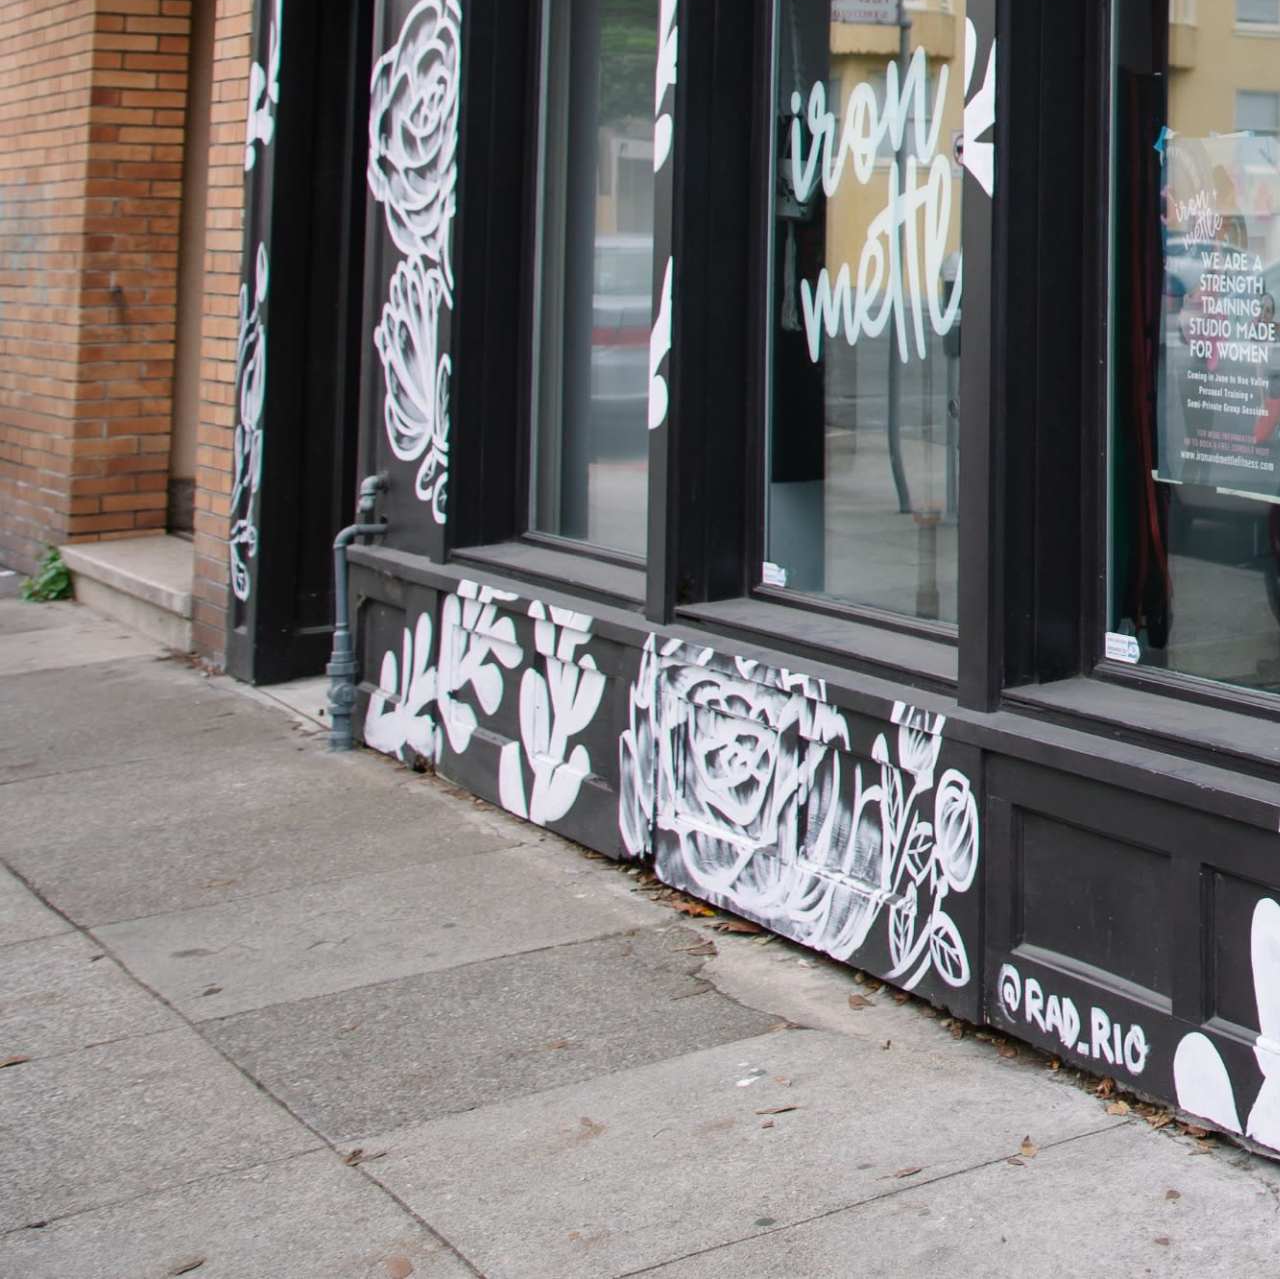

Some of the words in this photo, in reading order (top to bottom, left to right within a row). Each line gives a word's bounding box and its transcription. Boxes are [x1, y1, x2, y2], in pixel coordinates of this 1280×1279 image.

[791, 46, 949, 202] iron
[801, 154, 963, 363] mettl
[1201, 252, 1222, 270] WE
[1224, 253, 1248, 271] ARE
[1252, 256, 1264, 272] A
[1200, 274, 1264, 295] STRENGTH
[1202, 296, 1262, 317] TRAINING
[1189, 318, 1231, 338] STUDIO
[1236, 323, 1276, 341] MADE
[1190, 340, 1213, 359] FOR
[1216, 342, 1269, 363] WOMEN
[1224, 388, 1249, 401] Training
[998, 963, 1151, 1076] @RAD_RIO
